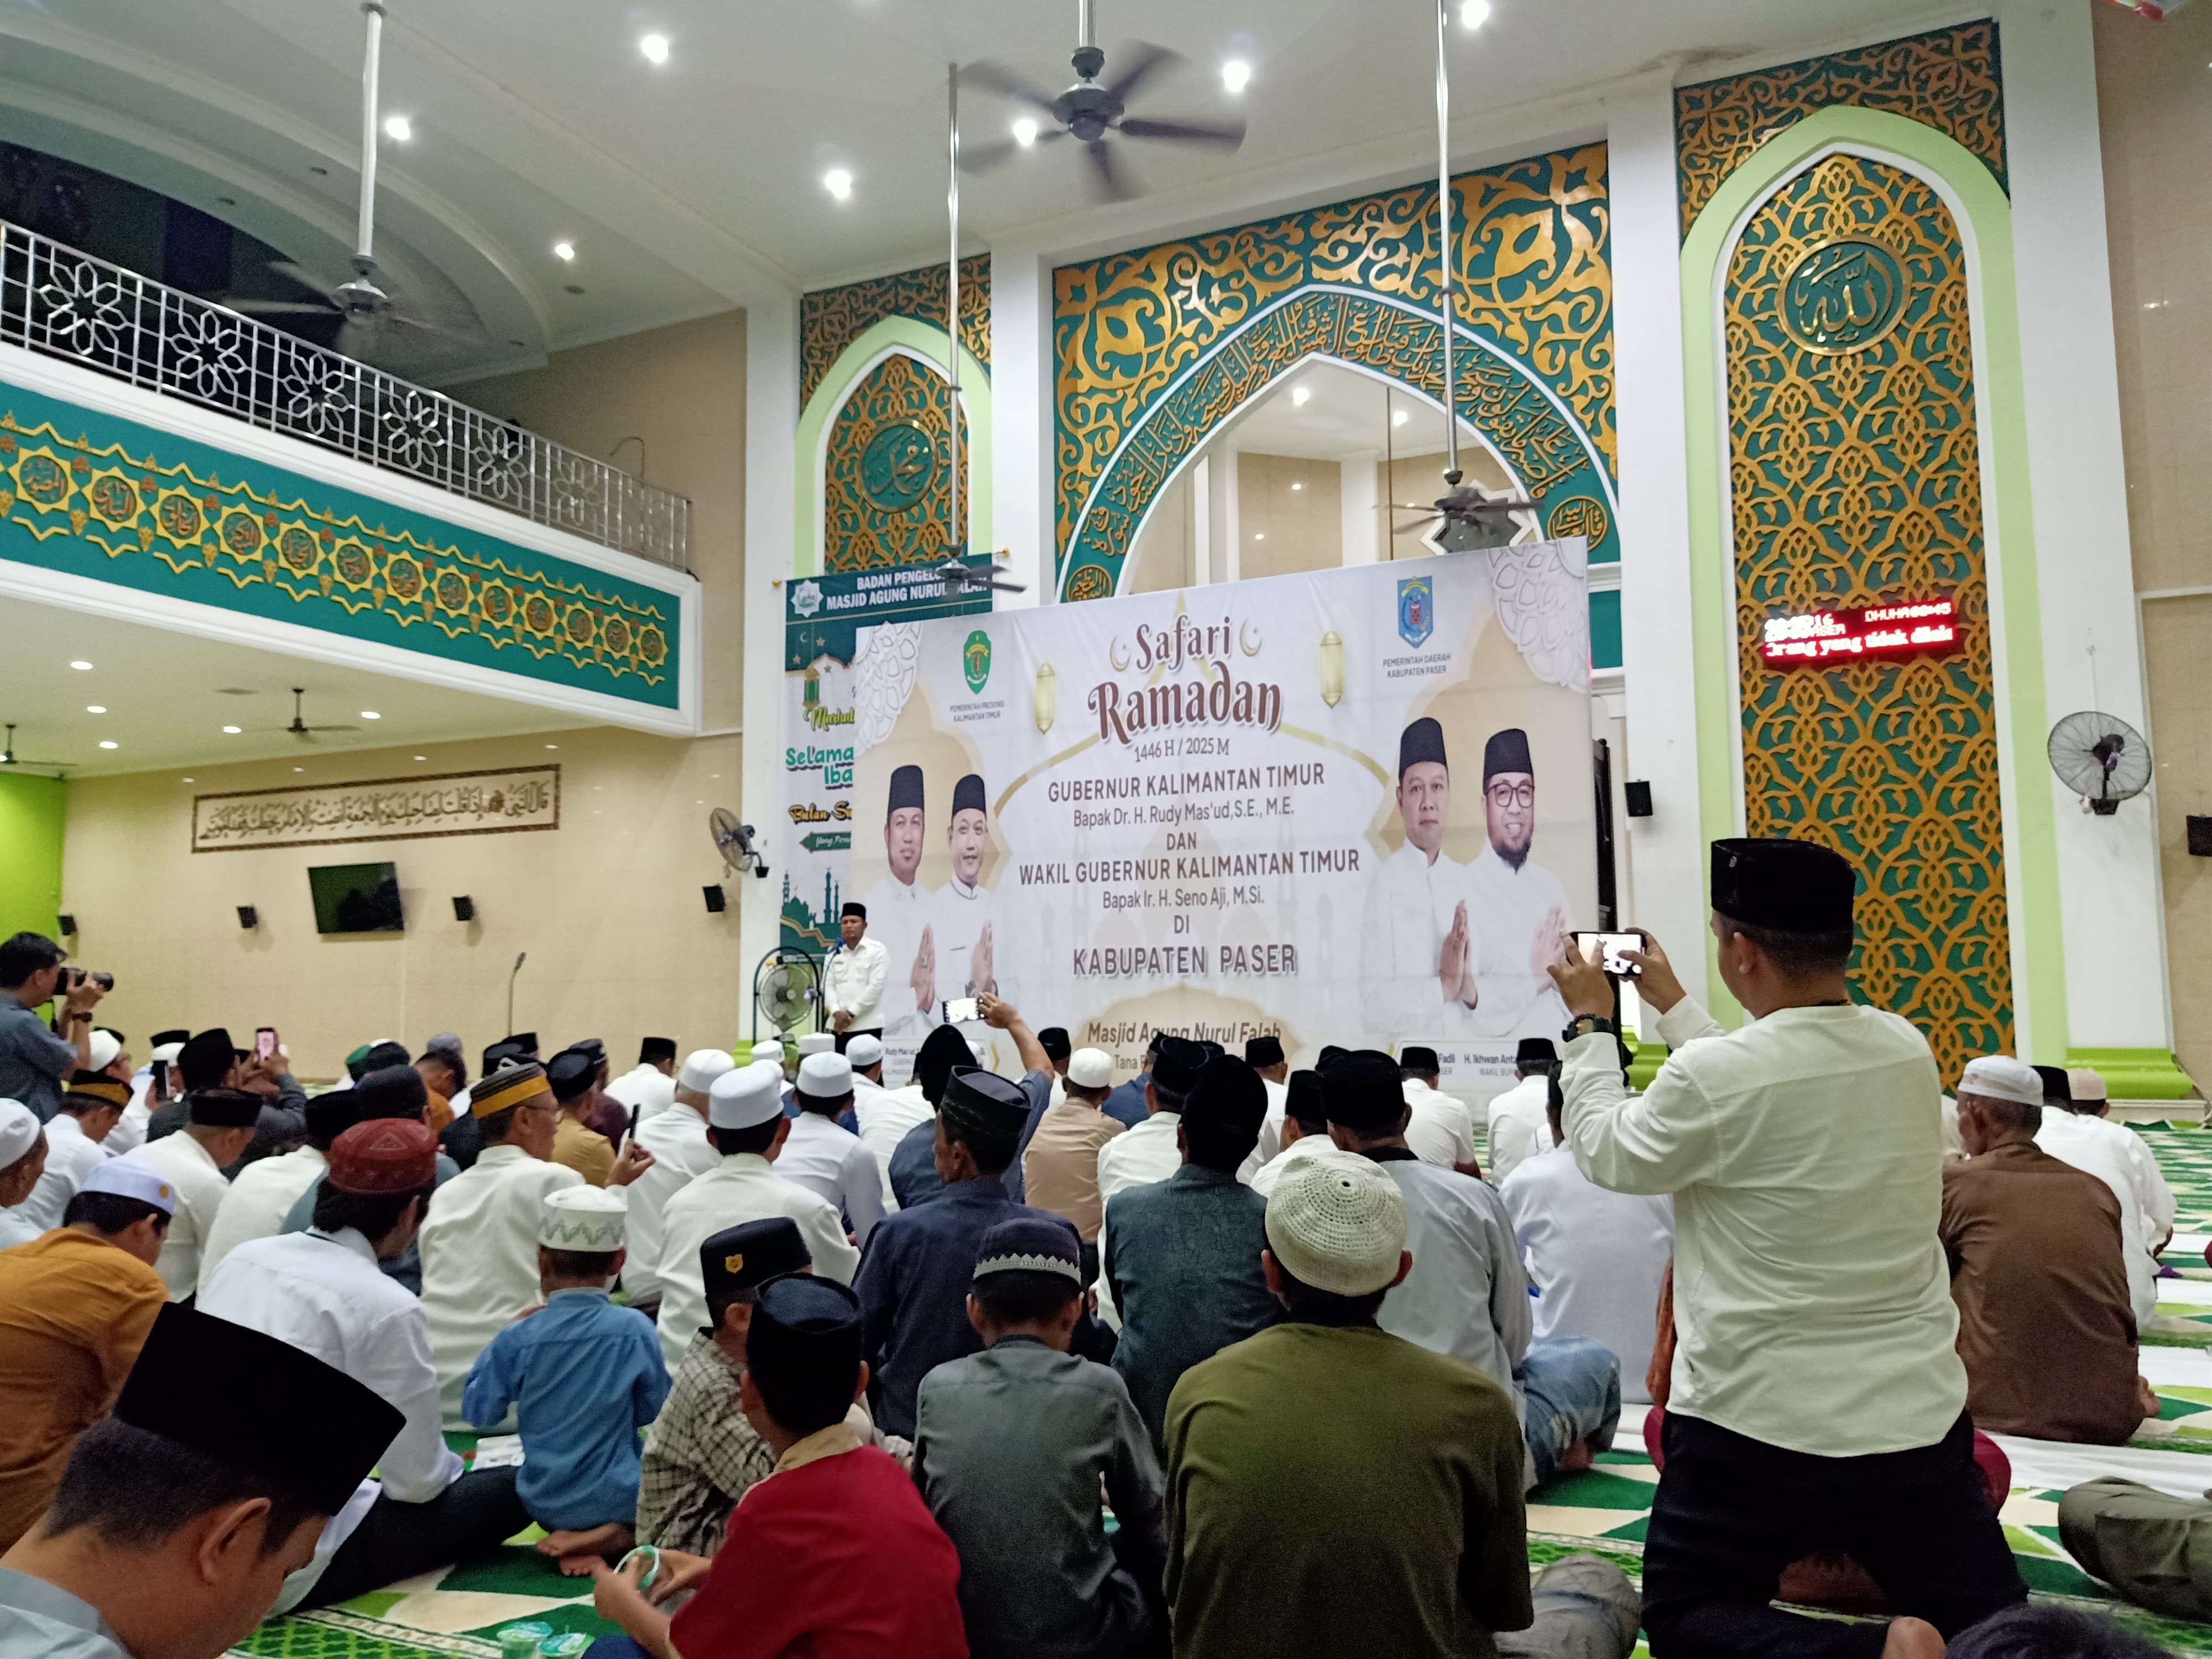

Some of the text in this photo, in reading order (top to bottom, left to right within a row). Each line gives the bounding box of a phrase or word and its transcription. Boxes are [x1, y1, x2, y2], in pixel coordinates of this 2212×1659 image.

[857, 575, 892, 590] BADAN
[827, 593, 866, 610] MASJID
[869, 588, 907, 606] AGUNG
[910, 583, 947, 601] NURUL
[1136, 615, 1231, 670] Safari
[1383, 653, 1451, 667] PEMERINTAH DAERAH
[1387, 665, 1447, 679] KABUPATEN PASER
[950, 700, 1005, 713] PEMERINTAH PROVINSI
[1088, 661, 1281, 745] Ramadan
[953, 711, 1001, 722] KALIMANTAN TIMUR
[1134, 739, 1162, 763] 1446
[1165, 740, 1175, 757] H
[1186, 738, 1213, 755] 2025
[1217, 739, 1230, 756] M
[1048, 763, 1325, 802] GUBERNUR KALIMANTAN TIMUR
[789, 802, 831, 825] Bulan
[1073, 808, 1111, 831] Bapak
[1113, 807, 1132, 826] Dr.
[1134, 806, 1147, 824] H.
[1150, 804, 1181, 826] Rudy
[1266, 796, 1295, 815] M.E.
[1166, 832, 1197, 852] DAN
[1019, 849, 1360, 886] WAKIL GUBERNUR KALIMANTAN TIMUR
[1103, 886, 1265, 914] Bapak Ir. H. Seno Aji, M.Si.
[1173, 915, 1190, 935] DI
[1073, 944, 1297, 977] KABUPATEN PASER
[1087, 1022, 1136, 1048] Masjid
[1115, 1055, 1138, 1070] Tana
[1464, 1055, 1472, 1065] H.
[1473, 1054, 1499, 1065] Ikhwan
